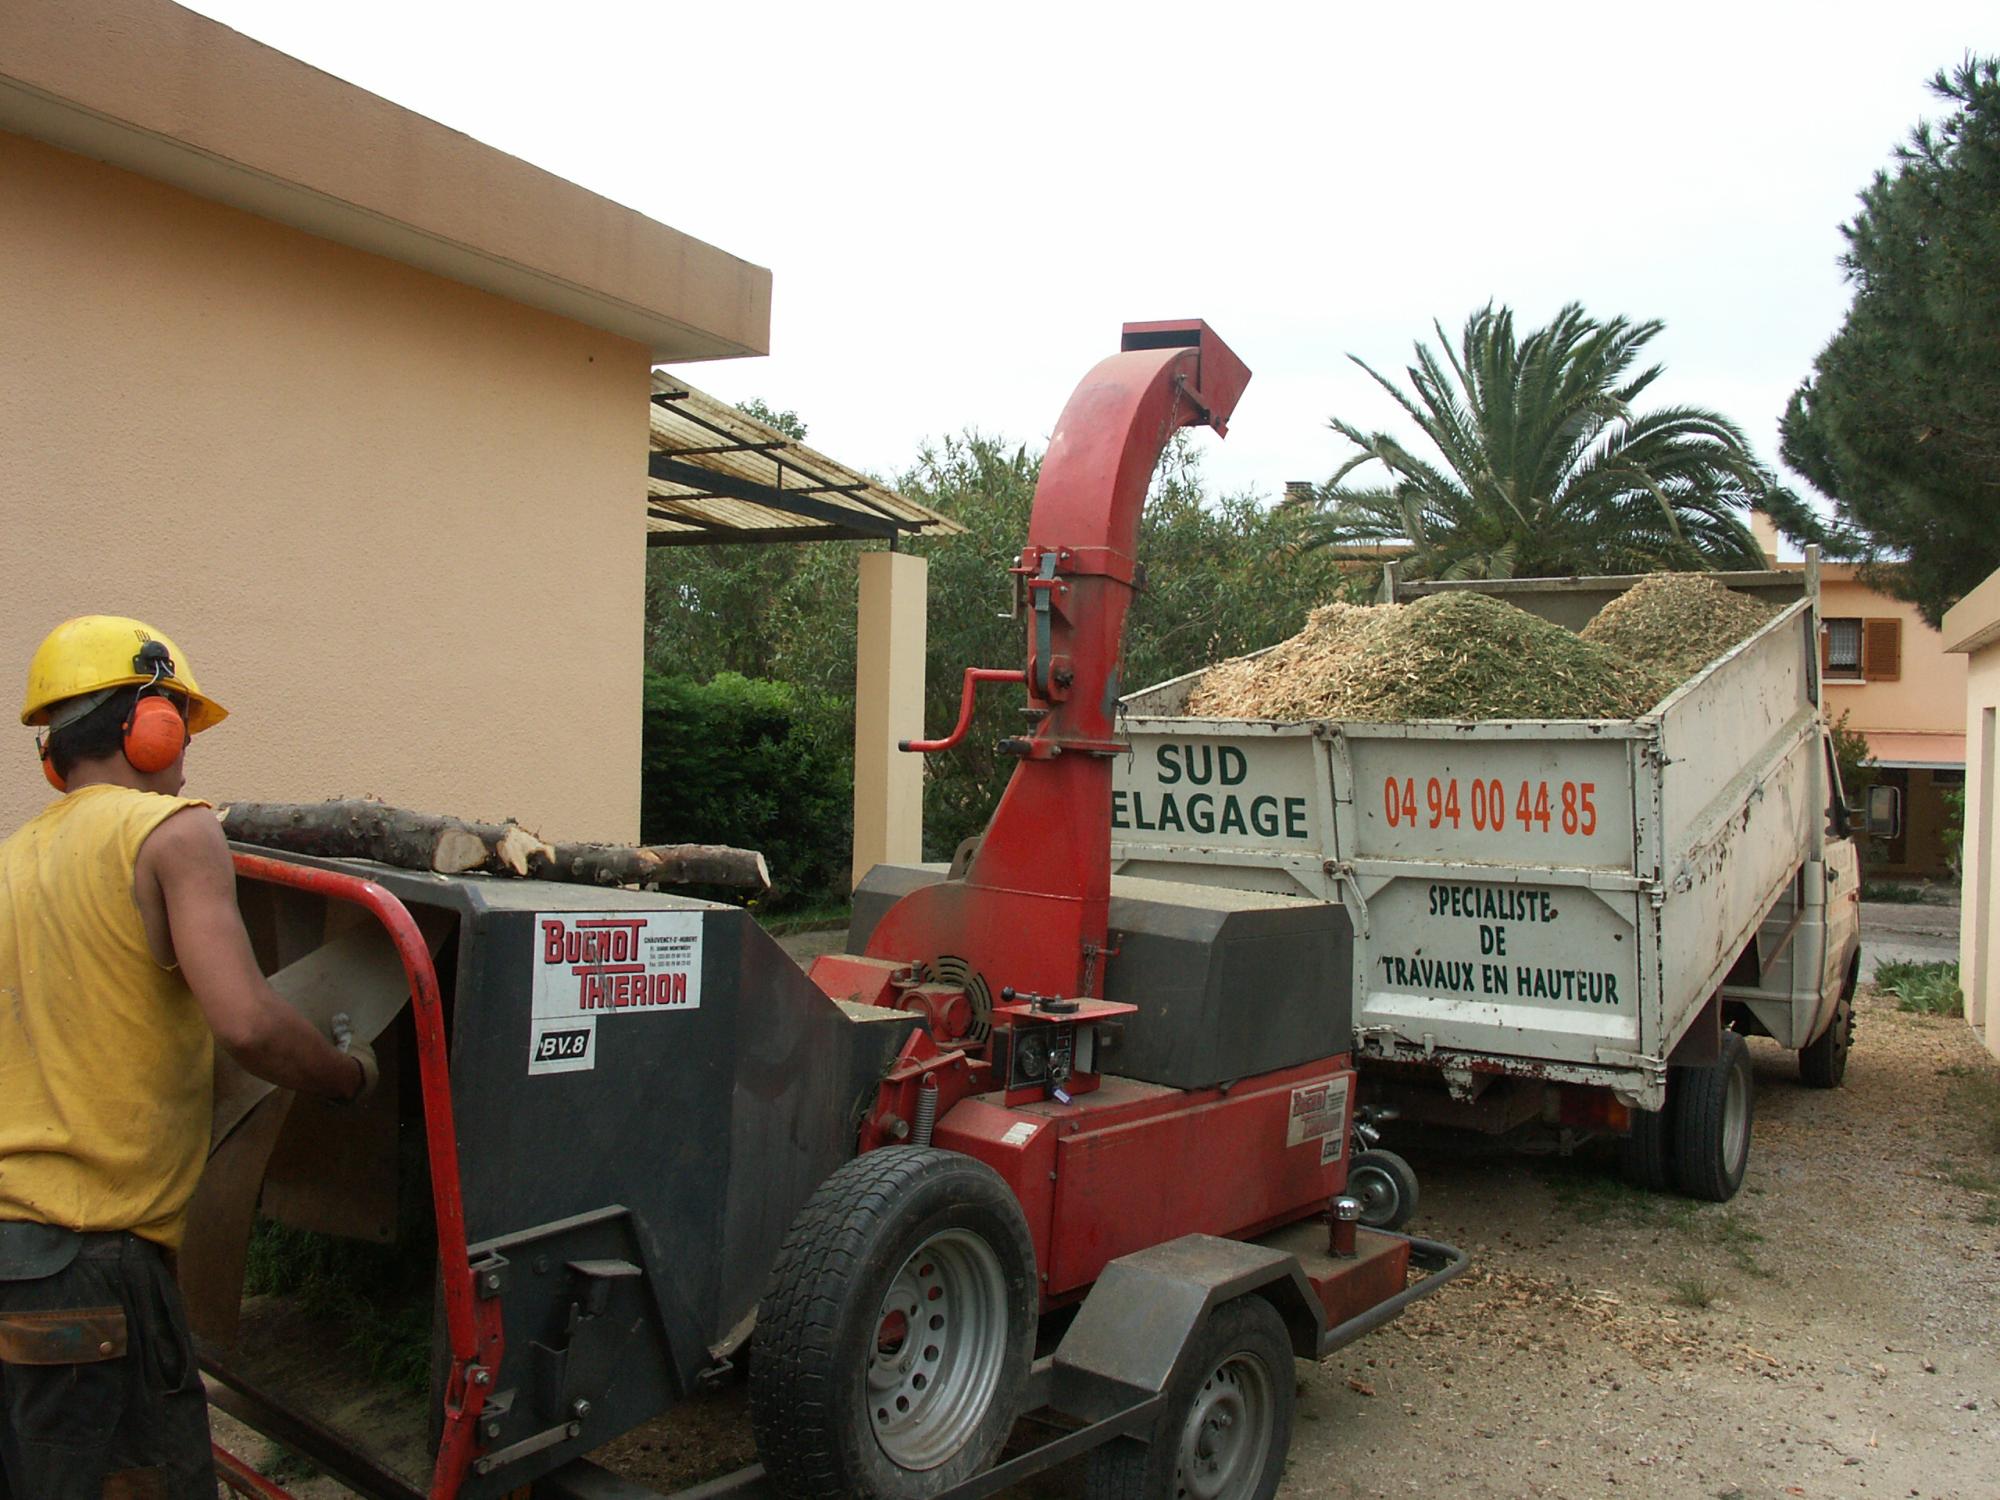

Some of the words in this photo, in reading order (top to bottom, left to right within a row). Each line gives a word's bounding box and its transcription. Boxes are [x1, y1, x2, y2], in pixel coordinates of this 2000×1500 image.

[1157, 744, 1247, 786] SUD
[1112, 791, 1308, 838] ELAGAGE
[1384, 776, 1418, 828] 04
[1426, 777, 1461, 830] 94
[1471, 778, 1505, 832] 00
[1516, 780, 1551, 833] 44
[1561, 781, 1597, 836] 85
[1428, 884, 1551, 923] SPECIALISTE
[542, 919, 647, 964] BUGNOT
[1480, 924, 1506, 956] DE
[572, 964, 687, 1009] THIERION
[1383, 956, 1475, 992] TRAVAUX
[1483, 963, 1508, 995] EN
[1516, 966, 1619, 1005] HAUTEUR
[541, 1035, 585, 1057] BV.8
